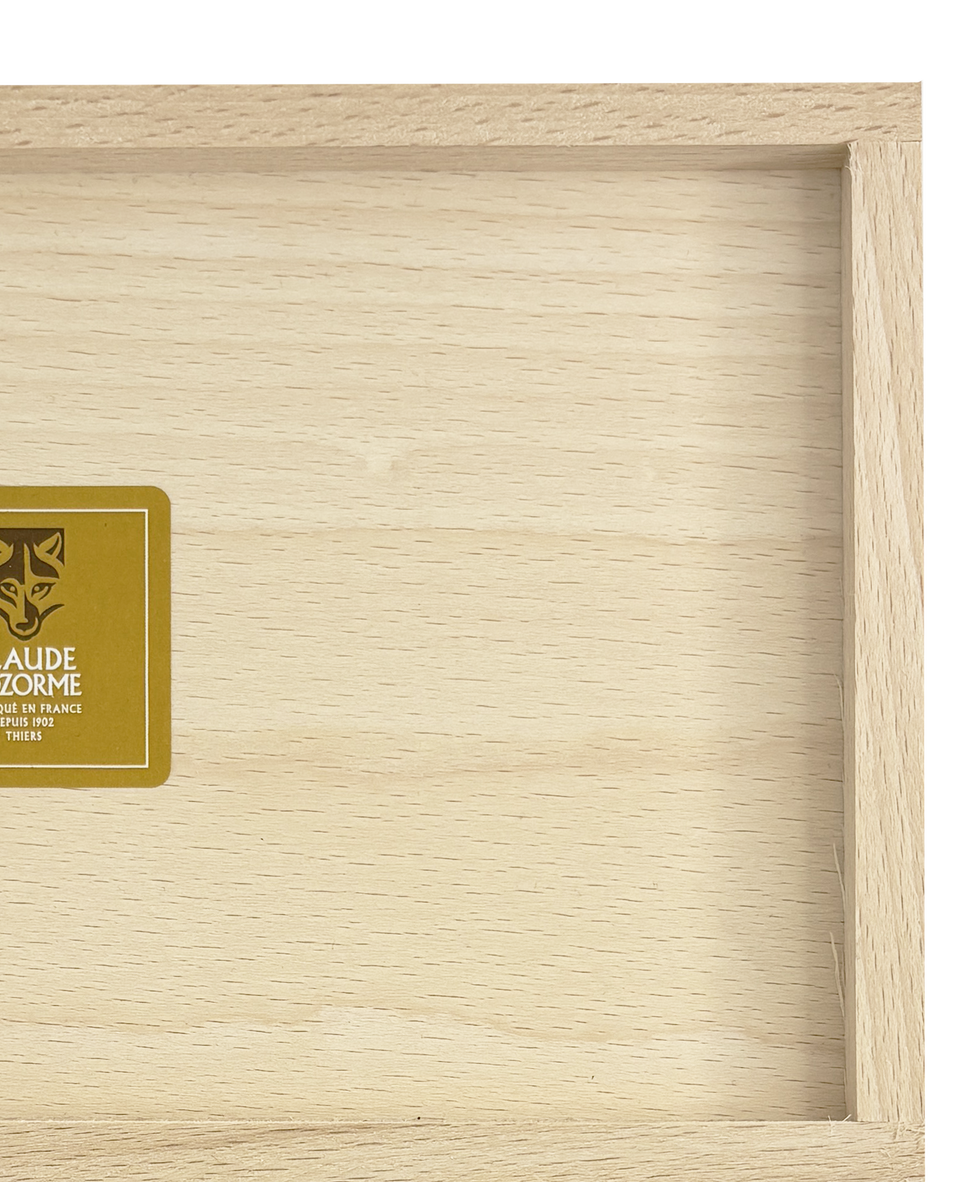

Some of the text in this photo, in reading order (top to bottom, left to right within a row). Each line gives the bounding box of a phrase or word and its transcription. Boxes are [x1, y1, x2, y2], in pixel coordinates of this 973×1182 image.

[22, 704, 36, 714] EN
[40, 704, 82, 714] FRANCE
[32, 717, 55, 728] 1902
[5, 731, 42, 742] THIERS
